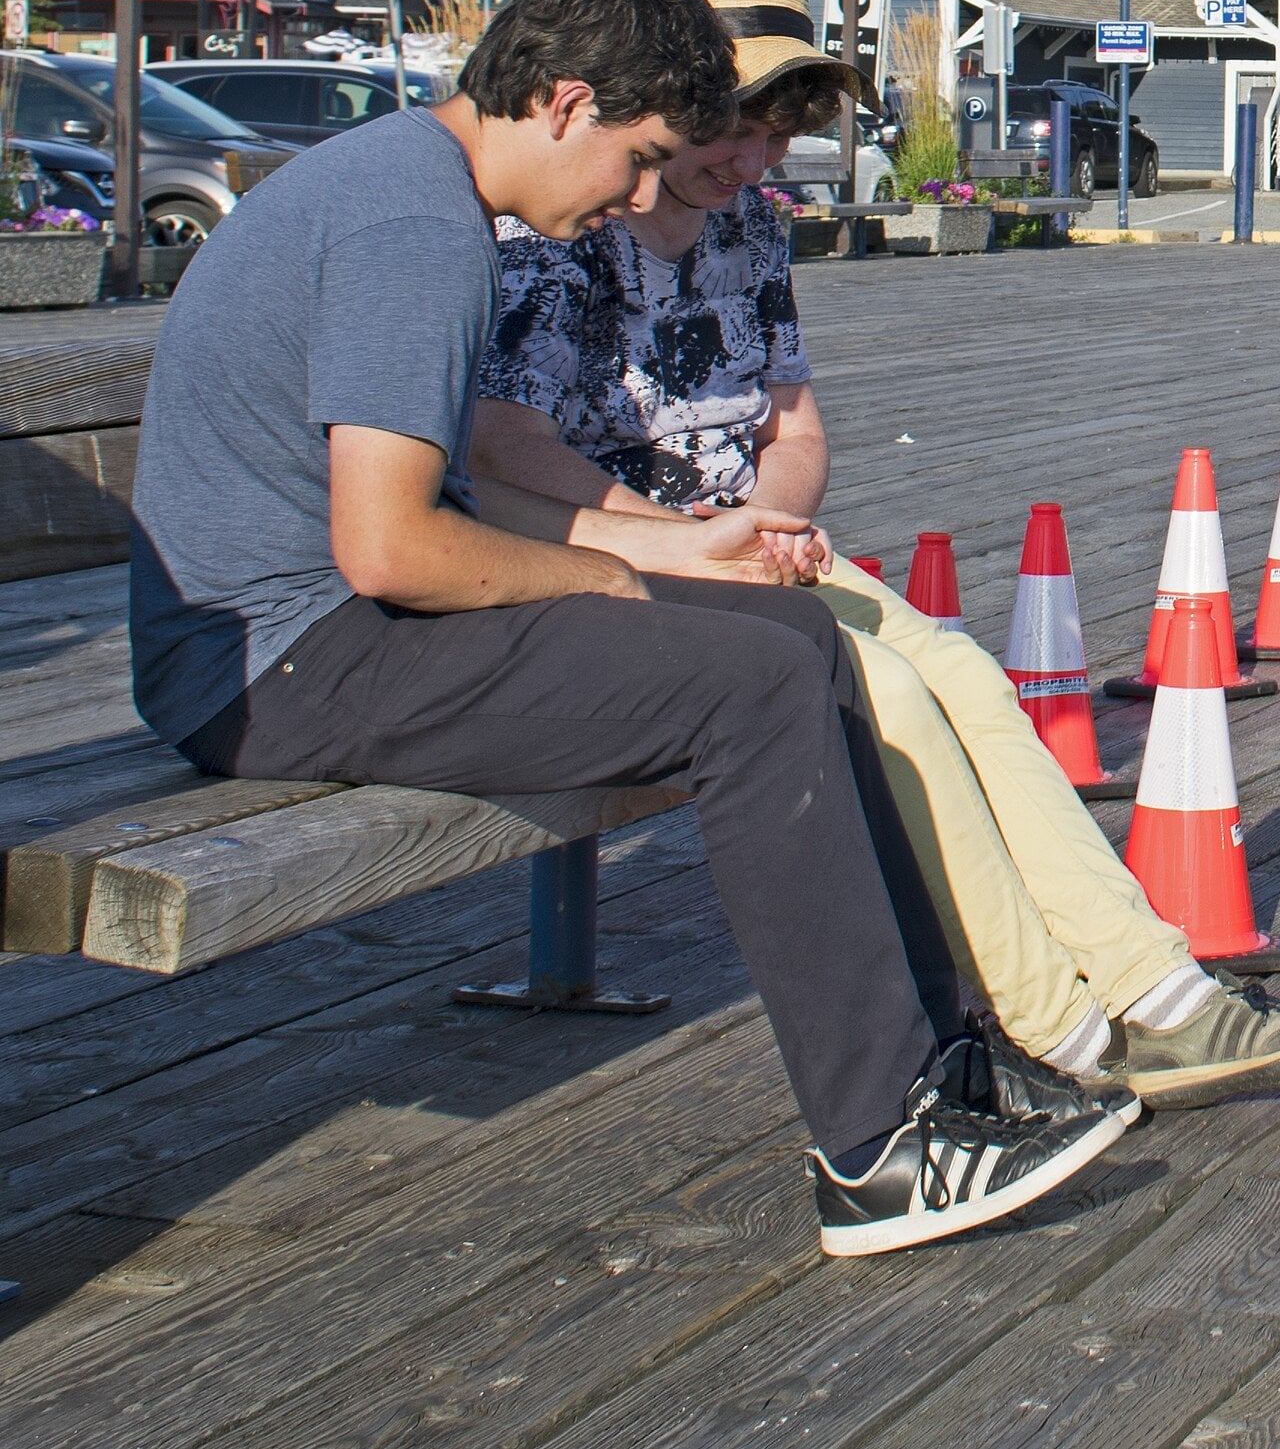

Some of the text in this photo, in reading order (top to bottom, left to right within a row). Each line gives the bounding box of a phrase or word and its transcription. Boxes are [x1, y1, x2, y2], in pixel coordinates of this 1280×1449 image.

[1207, 0, 1221, 20] P
[969, 100, 982, 117] P
[1025, 677, 1082, 688] PROPERTY
